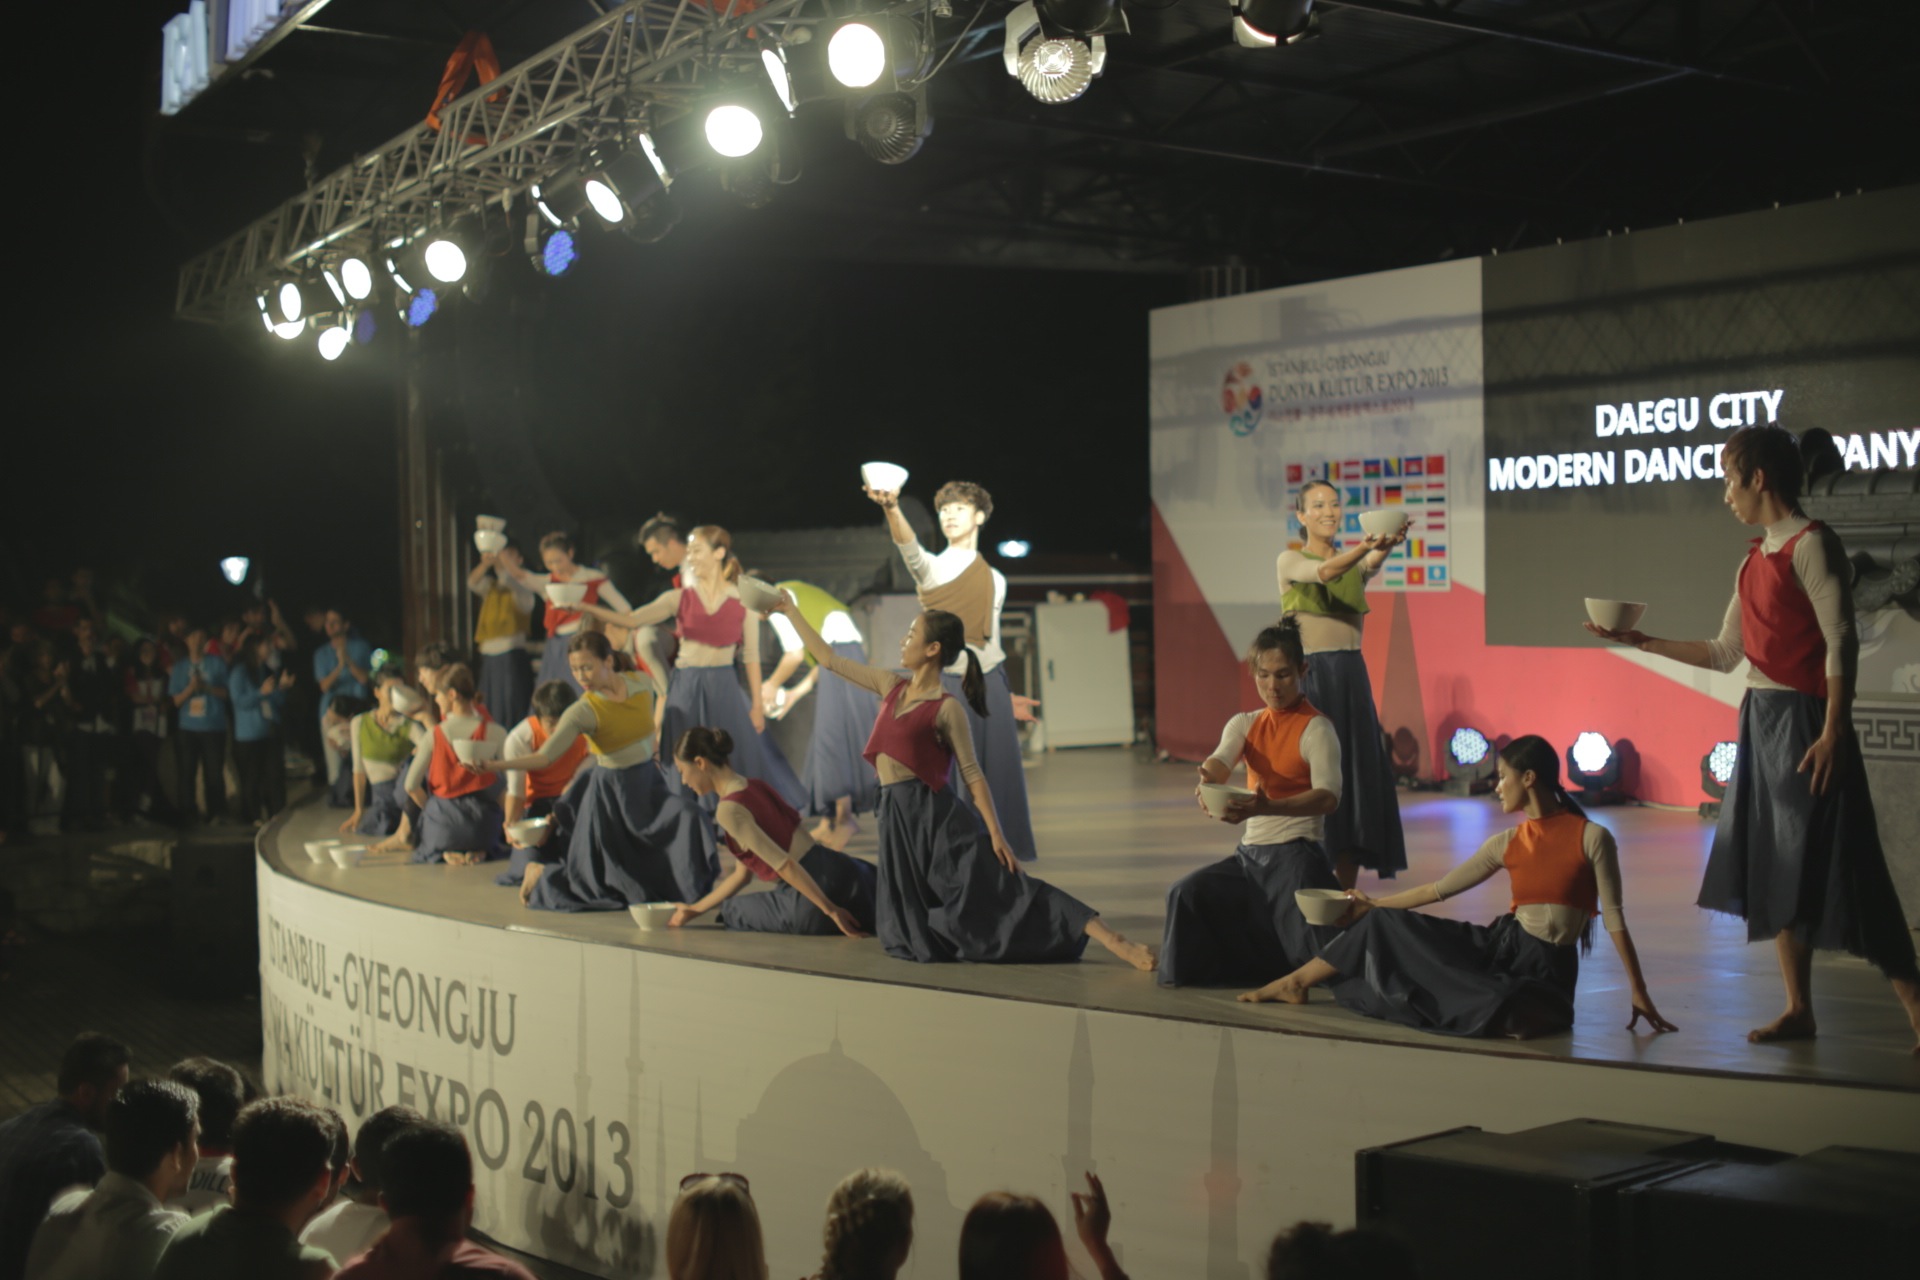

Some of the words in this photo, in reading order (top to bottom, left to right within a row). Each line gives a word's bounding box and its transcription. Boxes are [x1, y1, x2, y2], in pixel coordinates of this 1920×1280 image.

[1377, 368, 1418, 393] EXPO
[1419, 365, 1450, 389] 2013
[1595, 397, 1700, 437] DAEGU
[1708, 389, 1784, 428] CITY
[1489, 451, 1615, 491] MODERN
[522, 1099, 634, 1209] 2013
